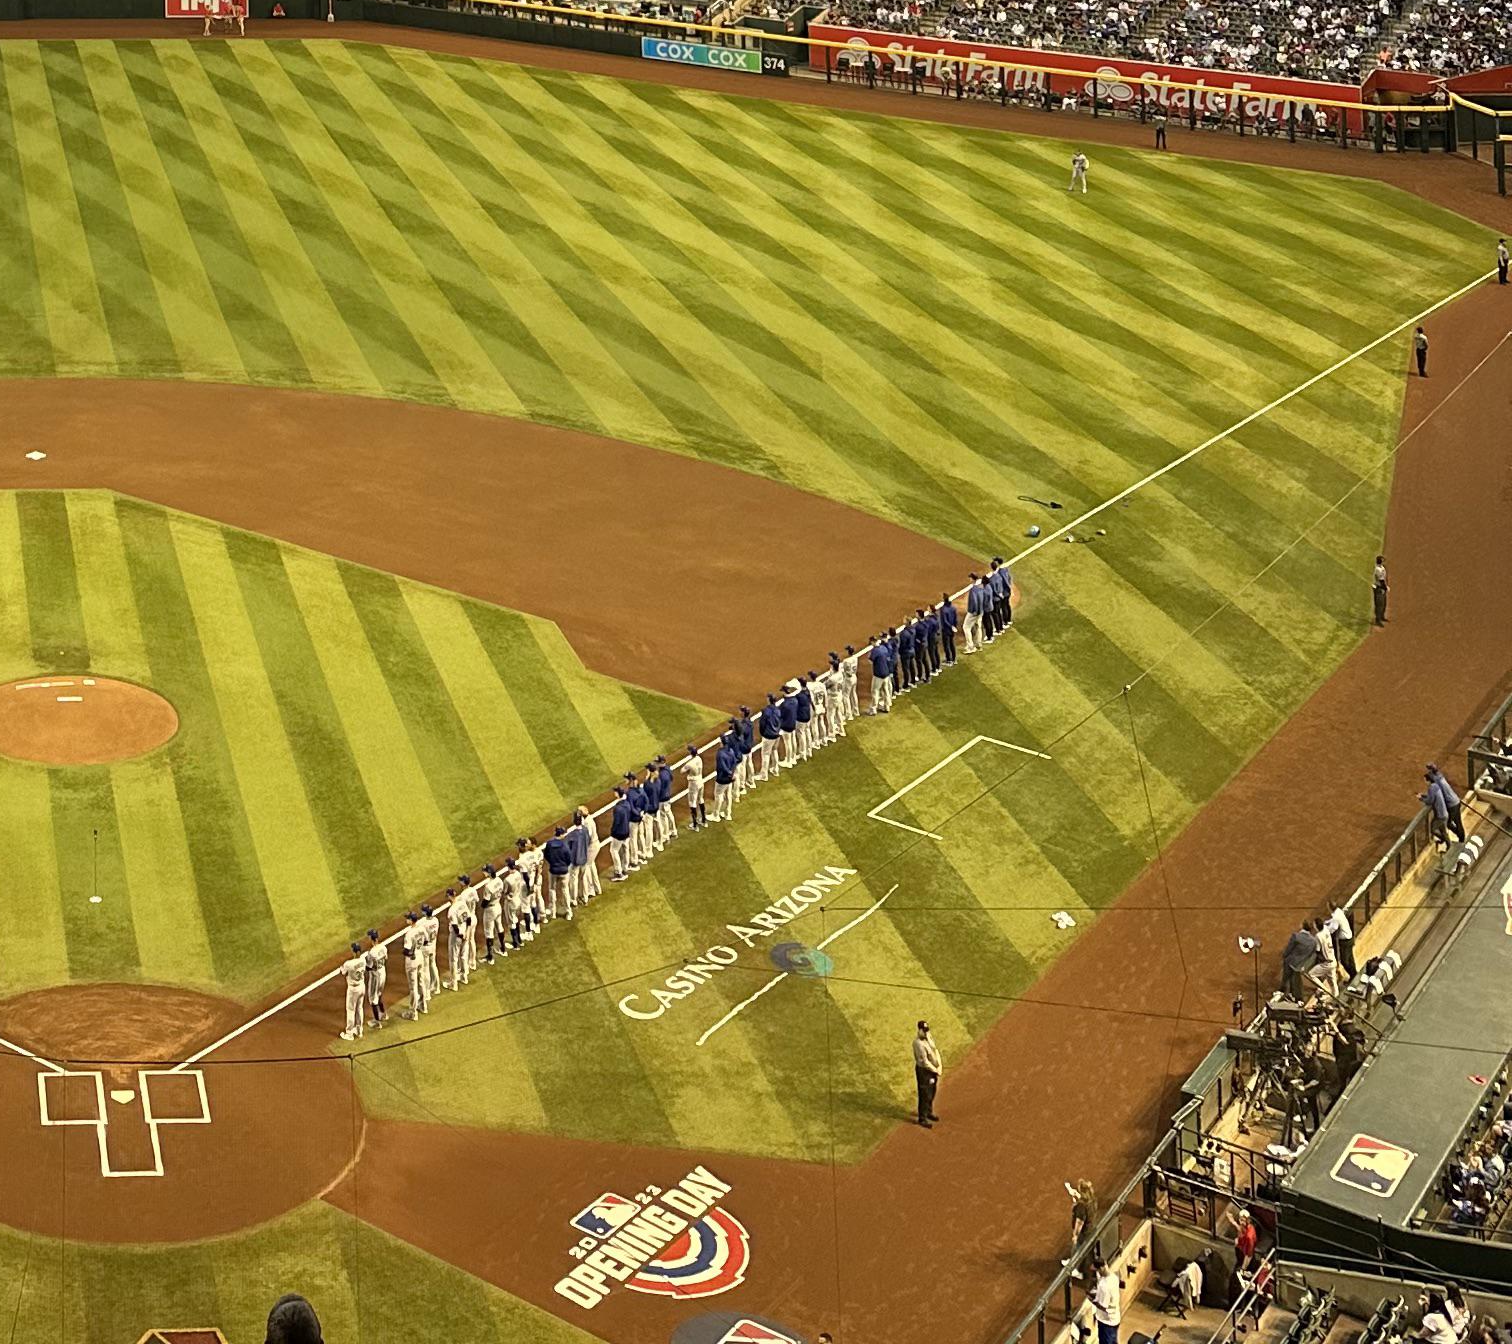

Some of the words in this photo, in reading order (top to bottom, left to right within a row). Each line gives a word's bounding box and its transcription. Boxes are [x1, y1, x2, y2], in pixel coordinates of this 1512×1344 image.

[656, 42, 695, 61] COX
[708, 50, 747, 68] COX
[764, 57, 785, 71] 374
[618, 945, 739, 1022] CASINO
[726, 865, 858, 945] ARIZONA
[635, 1185, 662, 1205] 23
[553, 1205, 689, 1310] OPENING
[660, 1165, 732, 1219] DAY
[569, 1237, 598, 1260] 20
